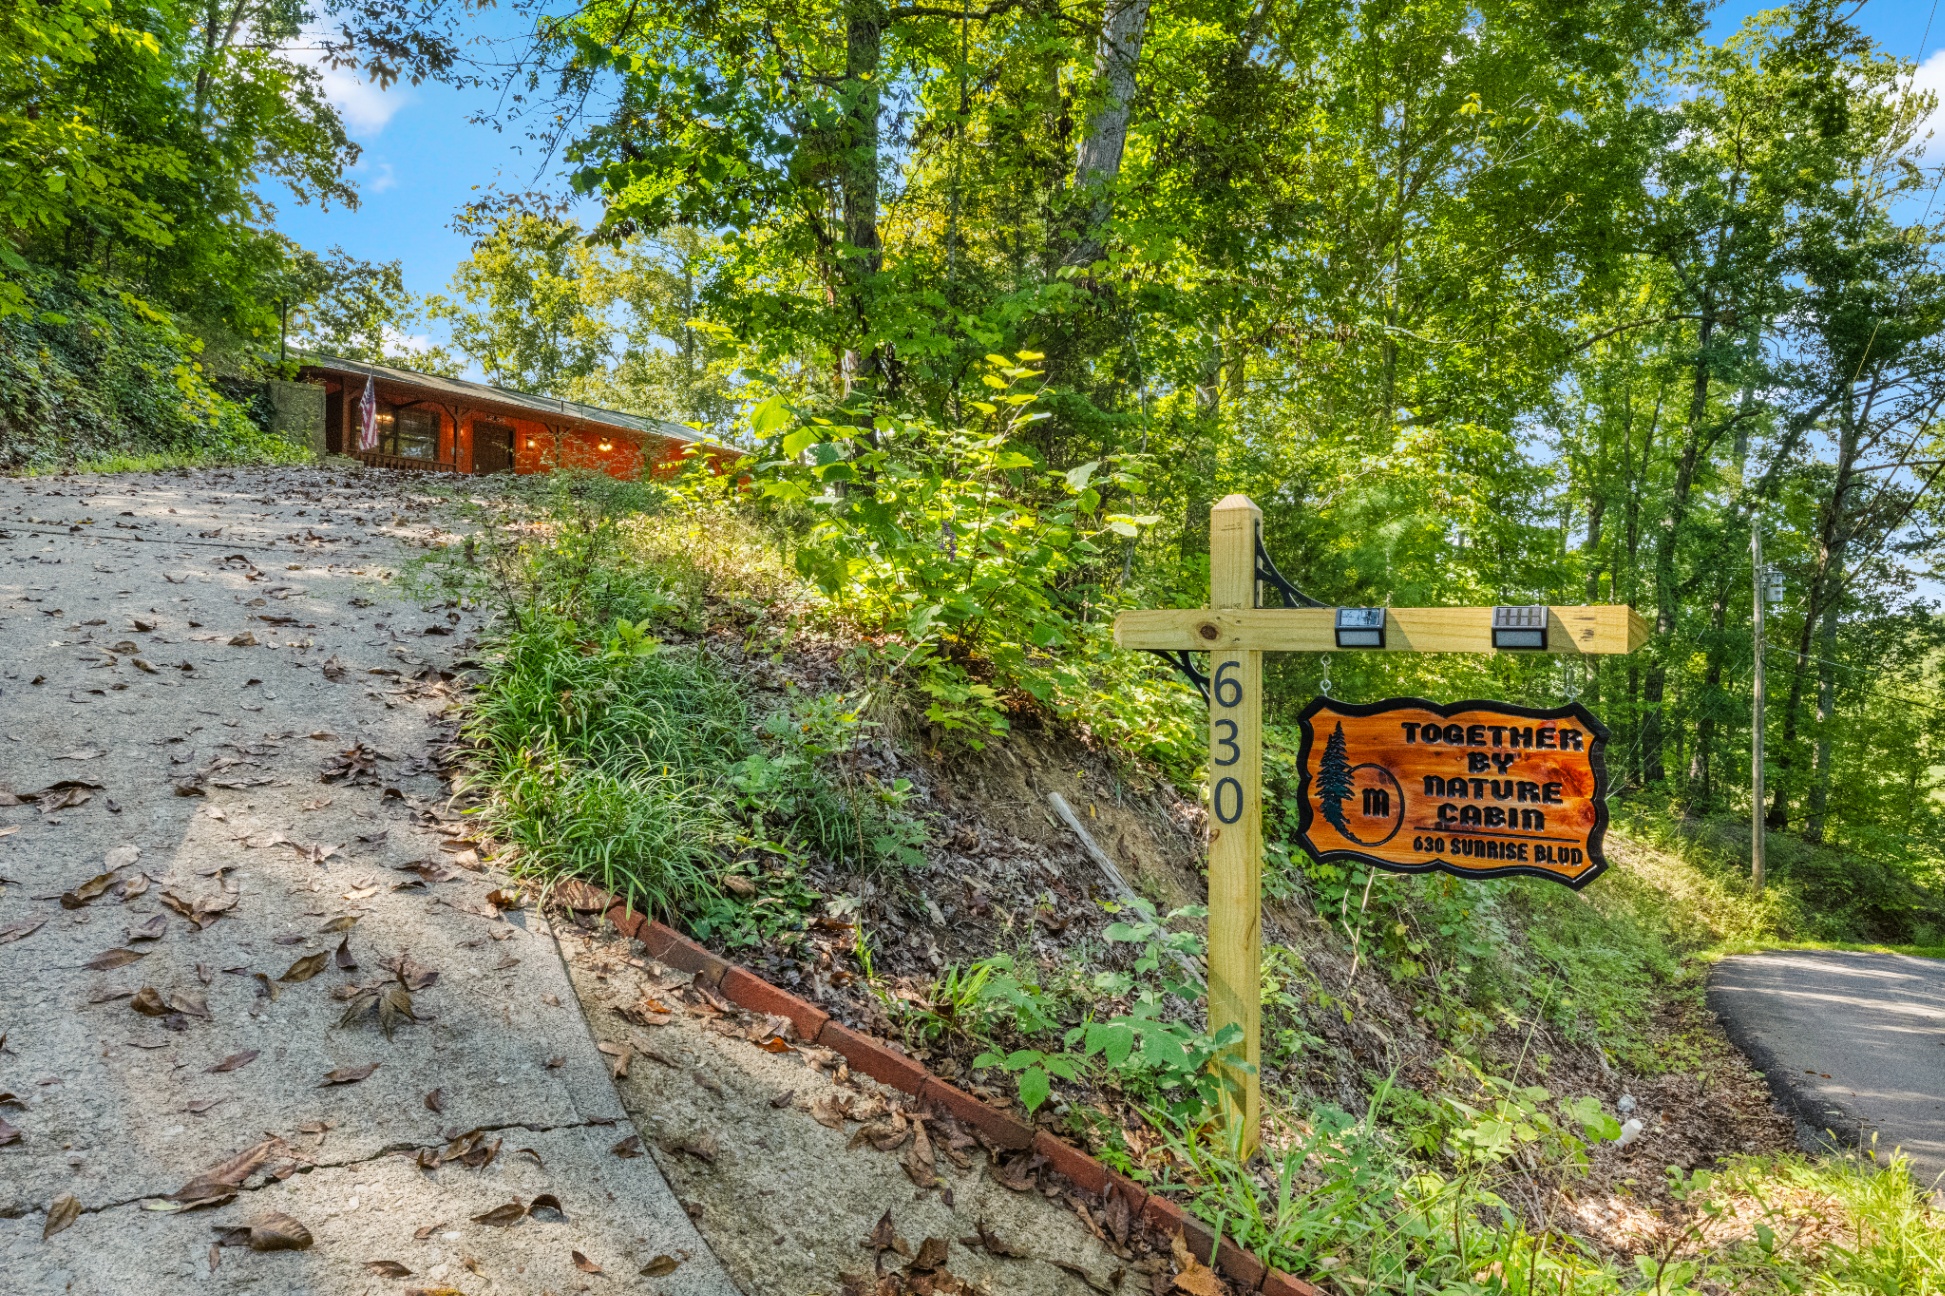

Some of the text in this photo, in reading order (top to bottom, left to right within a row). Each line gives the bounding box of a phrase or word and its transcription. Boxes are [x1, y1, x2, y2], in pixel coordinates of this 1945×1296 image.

[1214, 660, 1243, 825] 630
[1401, 722, 1584, 752] TOGETHER
[1467, 751, 1514, 775] BY
[1423, 774, 1563, 805] NATURE
[1437, 803, 1545, 832] CABIN
[1413, 835, 1445, 854] 630
[1450, 838, 1529, 862] SUNRISE
